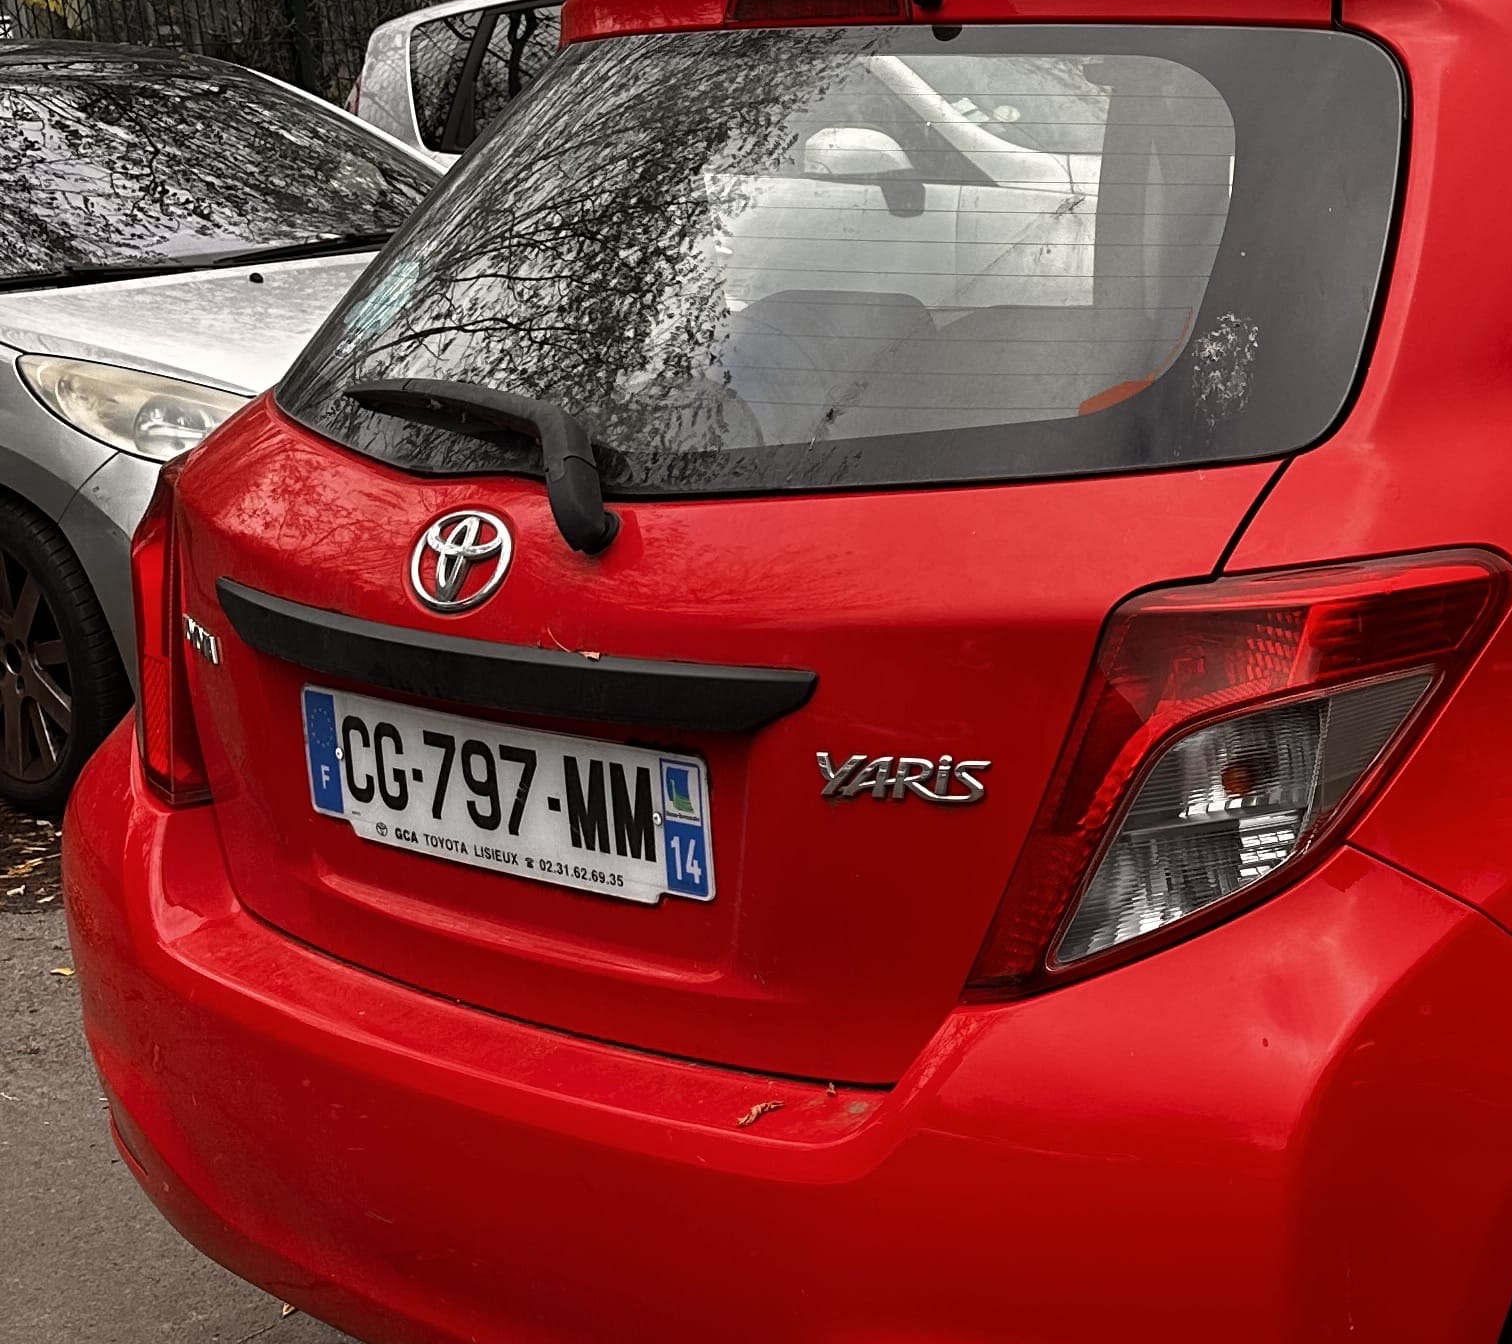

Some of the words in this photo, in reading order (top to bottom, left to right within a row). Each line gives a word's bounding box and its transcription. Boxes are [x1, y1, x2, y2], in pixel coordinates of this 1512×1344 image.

[321, 765, 331, 790] F
[341, 715, 657, 863] CG-797-MM
[395, 827, 419, 844] GCA
[423, 833, 469, 855] TOYOTA
[473, 845, 519, 866] LISIEUX
[539, 858, 624, 888] 02.31.62.69.35
[670, 835, 702, 885] 14
